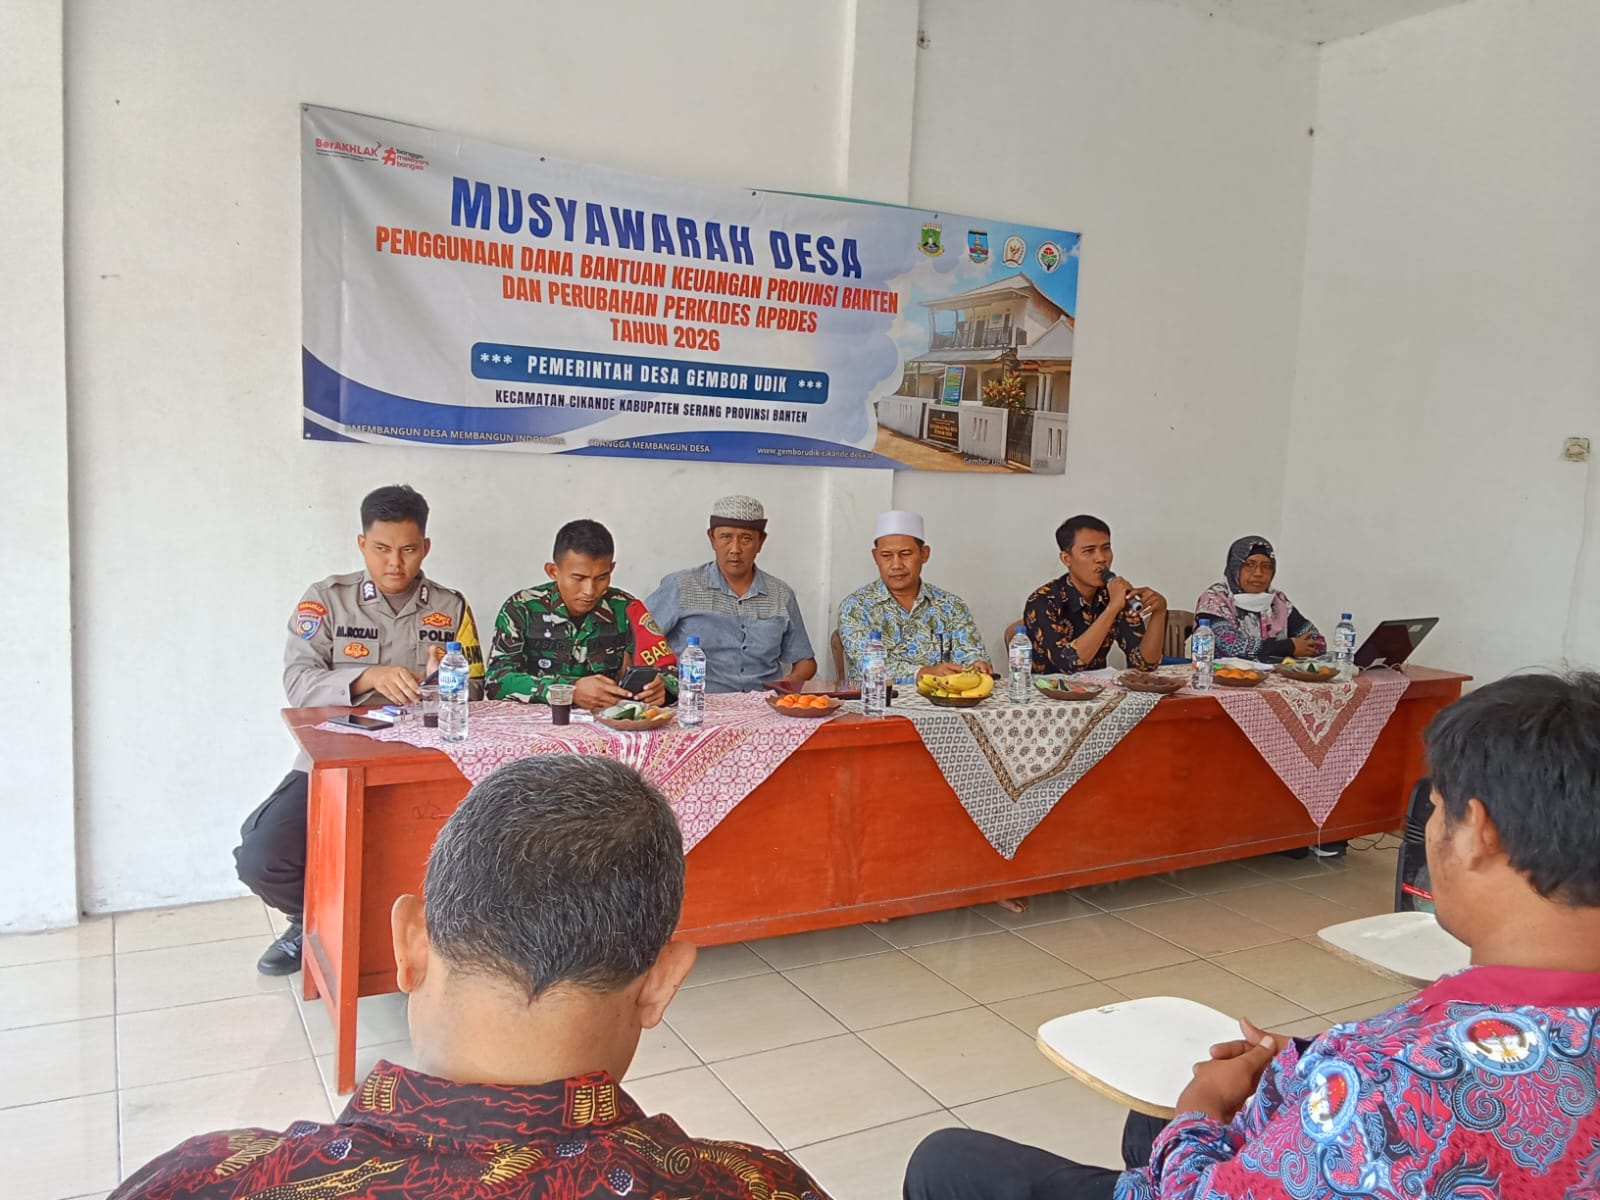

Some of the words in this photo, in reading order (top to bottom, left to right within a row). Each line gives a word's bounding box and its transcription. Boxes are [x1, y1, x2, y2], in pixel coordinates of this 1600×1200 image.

[315, 137, 379, 157] BerAKHLAK
[451, 176, 753, 265] MUSYAWARAH
[769, 229, 862, 279] DESA
[376, 226, 513, 269] PENGGUNAAN
[521, 247, 573, 276] DANA
[580, 254, 668, 286] BANTUAN
[672, 265, 762, 298] KEUANGAN
[767, 278, 839, 306] PROVINSI
[842, 288, 898, 314] BANTEN
[502, 274, 541, 303] DAN
[549, 281, 658, 317] PERUBAHAN
[663, 294, 750, 328] PERKADES
[755, 305, 817, 333] APBDES
[610, 318, 668, 346] TAHUN
[674, 325, 720, 352] 2026
[527, 355, 633, 382] PEMERINTAH
[640, 365, 679, 385] DESA
[686, 370, 748, 390] GEMBOR
[754, 375, 787, 393] UDIK
[495, 389, 566, 408] KECAMATAN
[569, 395, 616, 411] CIKANDE
[619, 399, 680, 416] KABUPATEN
[683, 403, 722, 418] SERANG
[725, 406, 770, 421] PROVINSI
[773, 410, 808, 424] BANTEN
[423, 429, 448, 438] DESA
[450, 431, 514, 442] MEMBANGUN
[632, 441, 688, 452] MEMBANGUN
[690, 444, 711, 453] DESA
[336, 626, 379, 639] M.ROZALI
